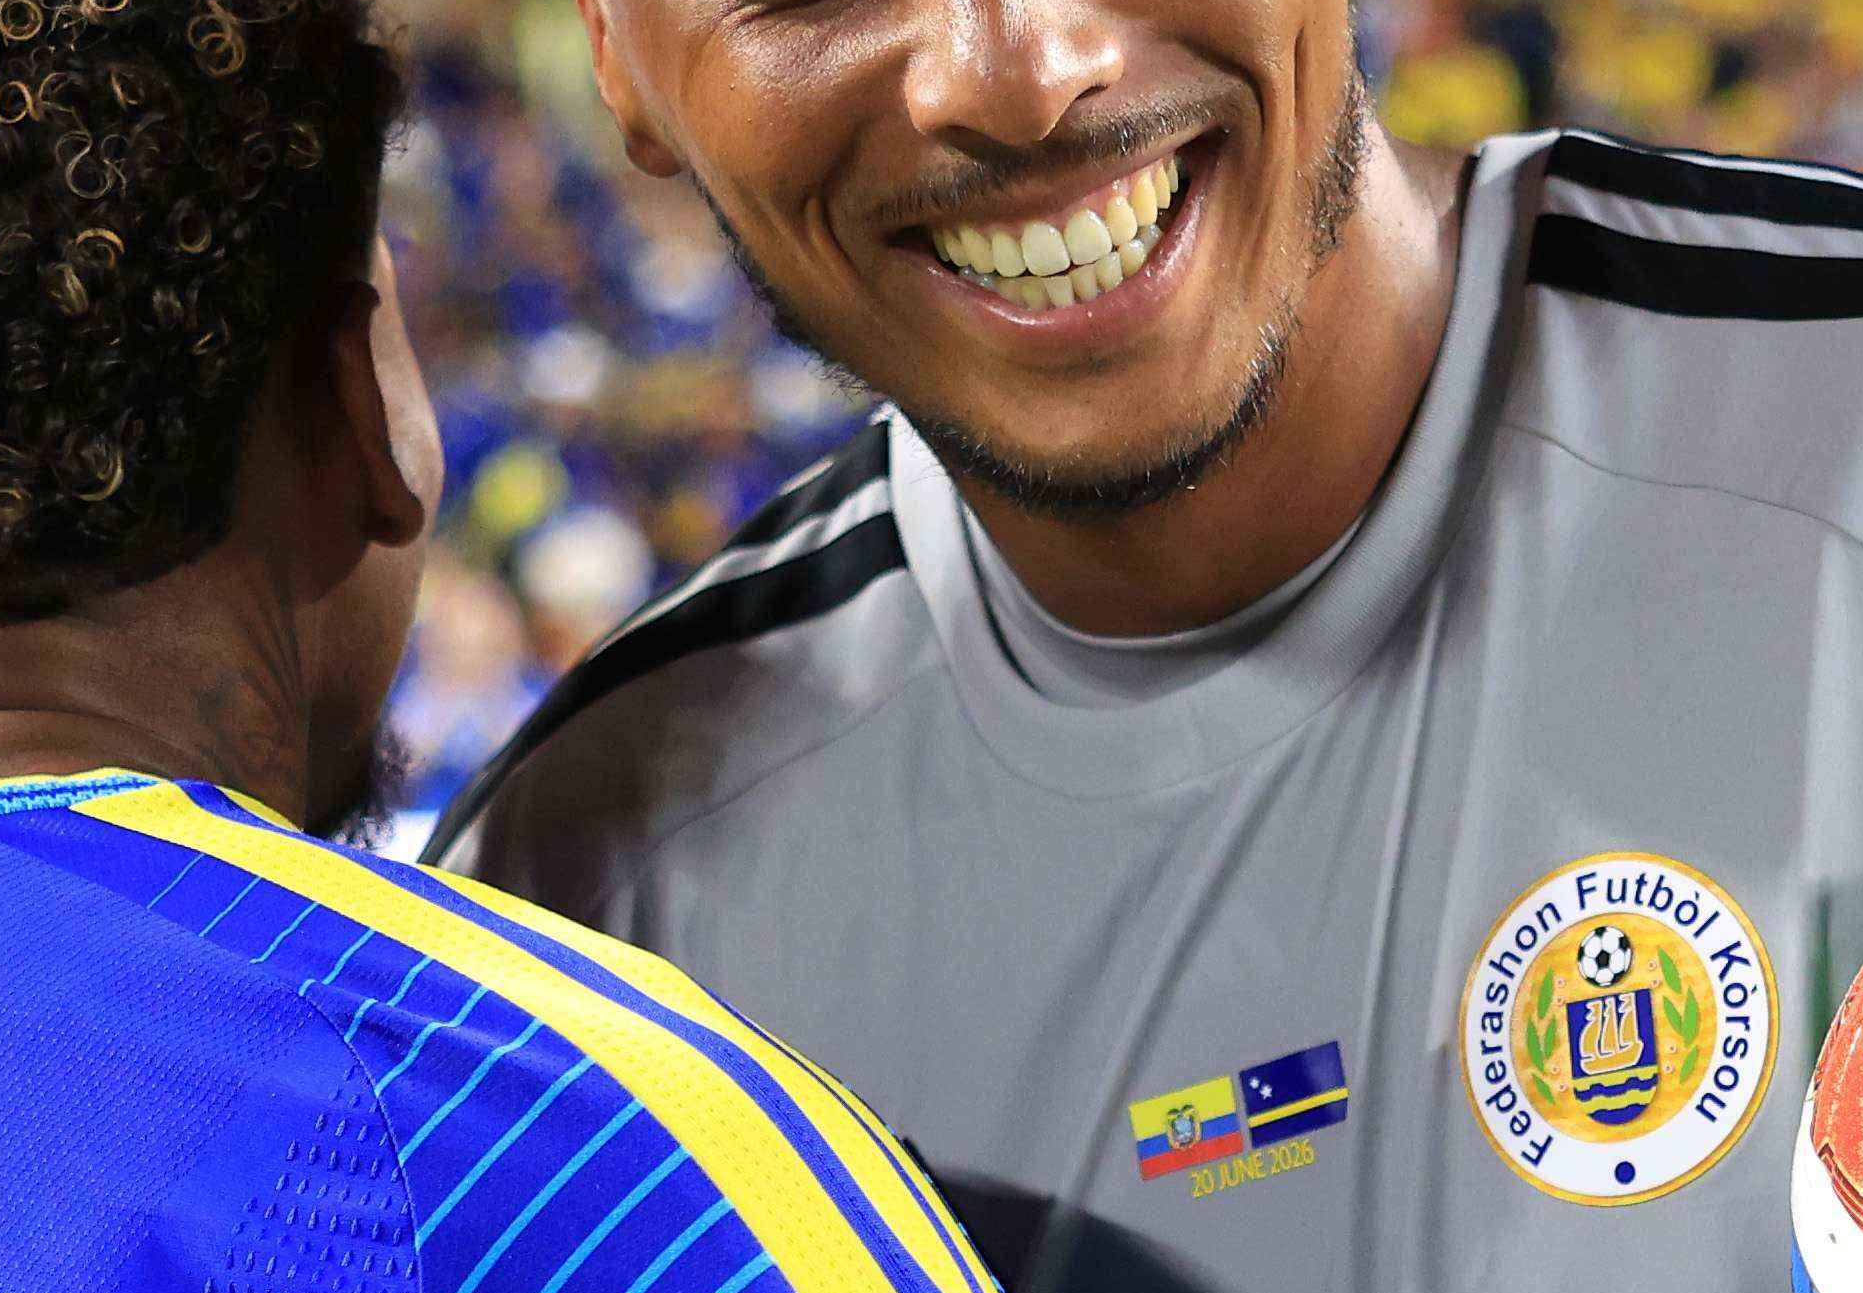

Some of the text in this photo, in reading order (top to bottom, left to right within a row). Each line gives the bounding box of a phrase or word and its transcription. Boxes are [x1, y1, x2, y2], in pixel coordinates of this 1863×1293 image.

[1481, 871, 1759, 1167] Federashon Futbòl Kòrsou
[1191, 1138, 1316, 1199] 20 JUNE 2026
